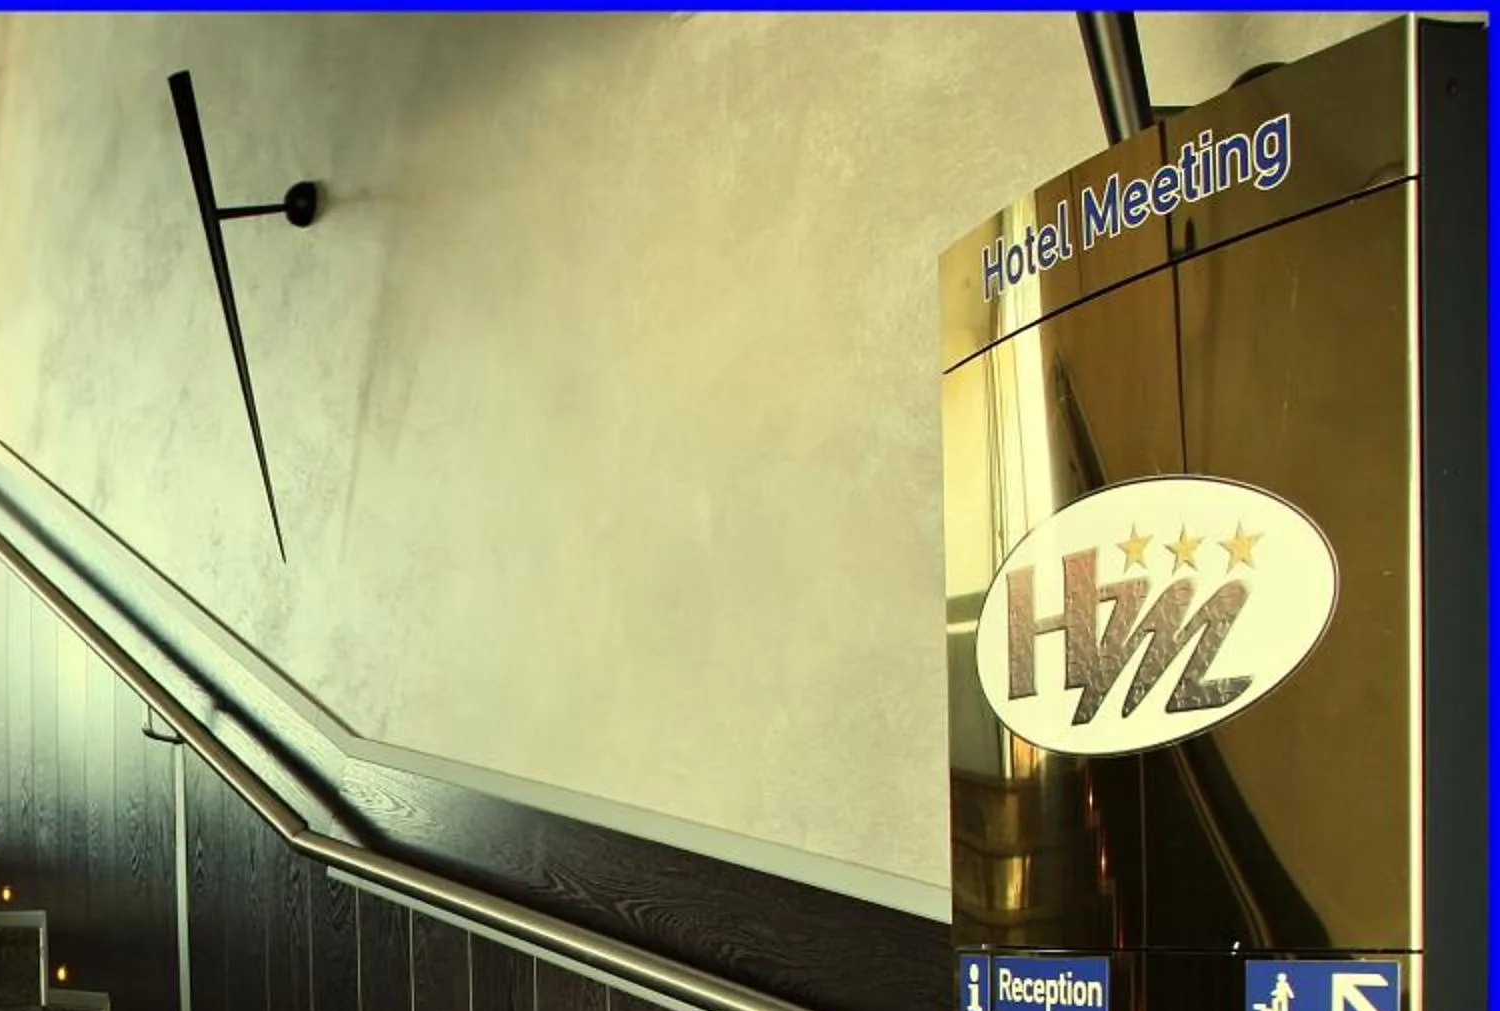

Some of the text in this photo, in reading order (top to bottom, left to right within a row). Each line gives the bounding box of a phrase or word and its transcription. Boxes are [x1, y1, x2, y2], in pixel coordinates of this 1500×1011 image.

[981, 113, 1291, 302] Hotel Meeting
[999, 961, 1103, 1011] Reception
